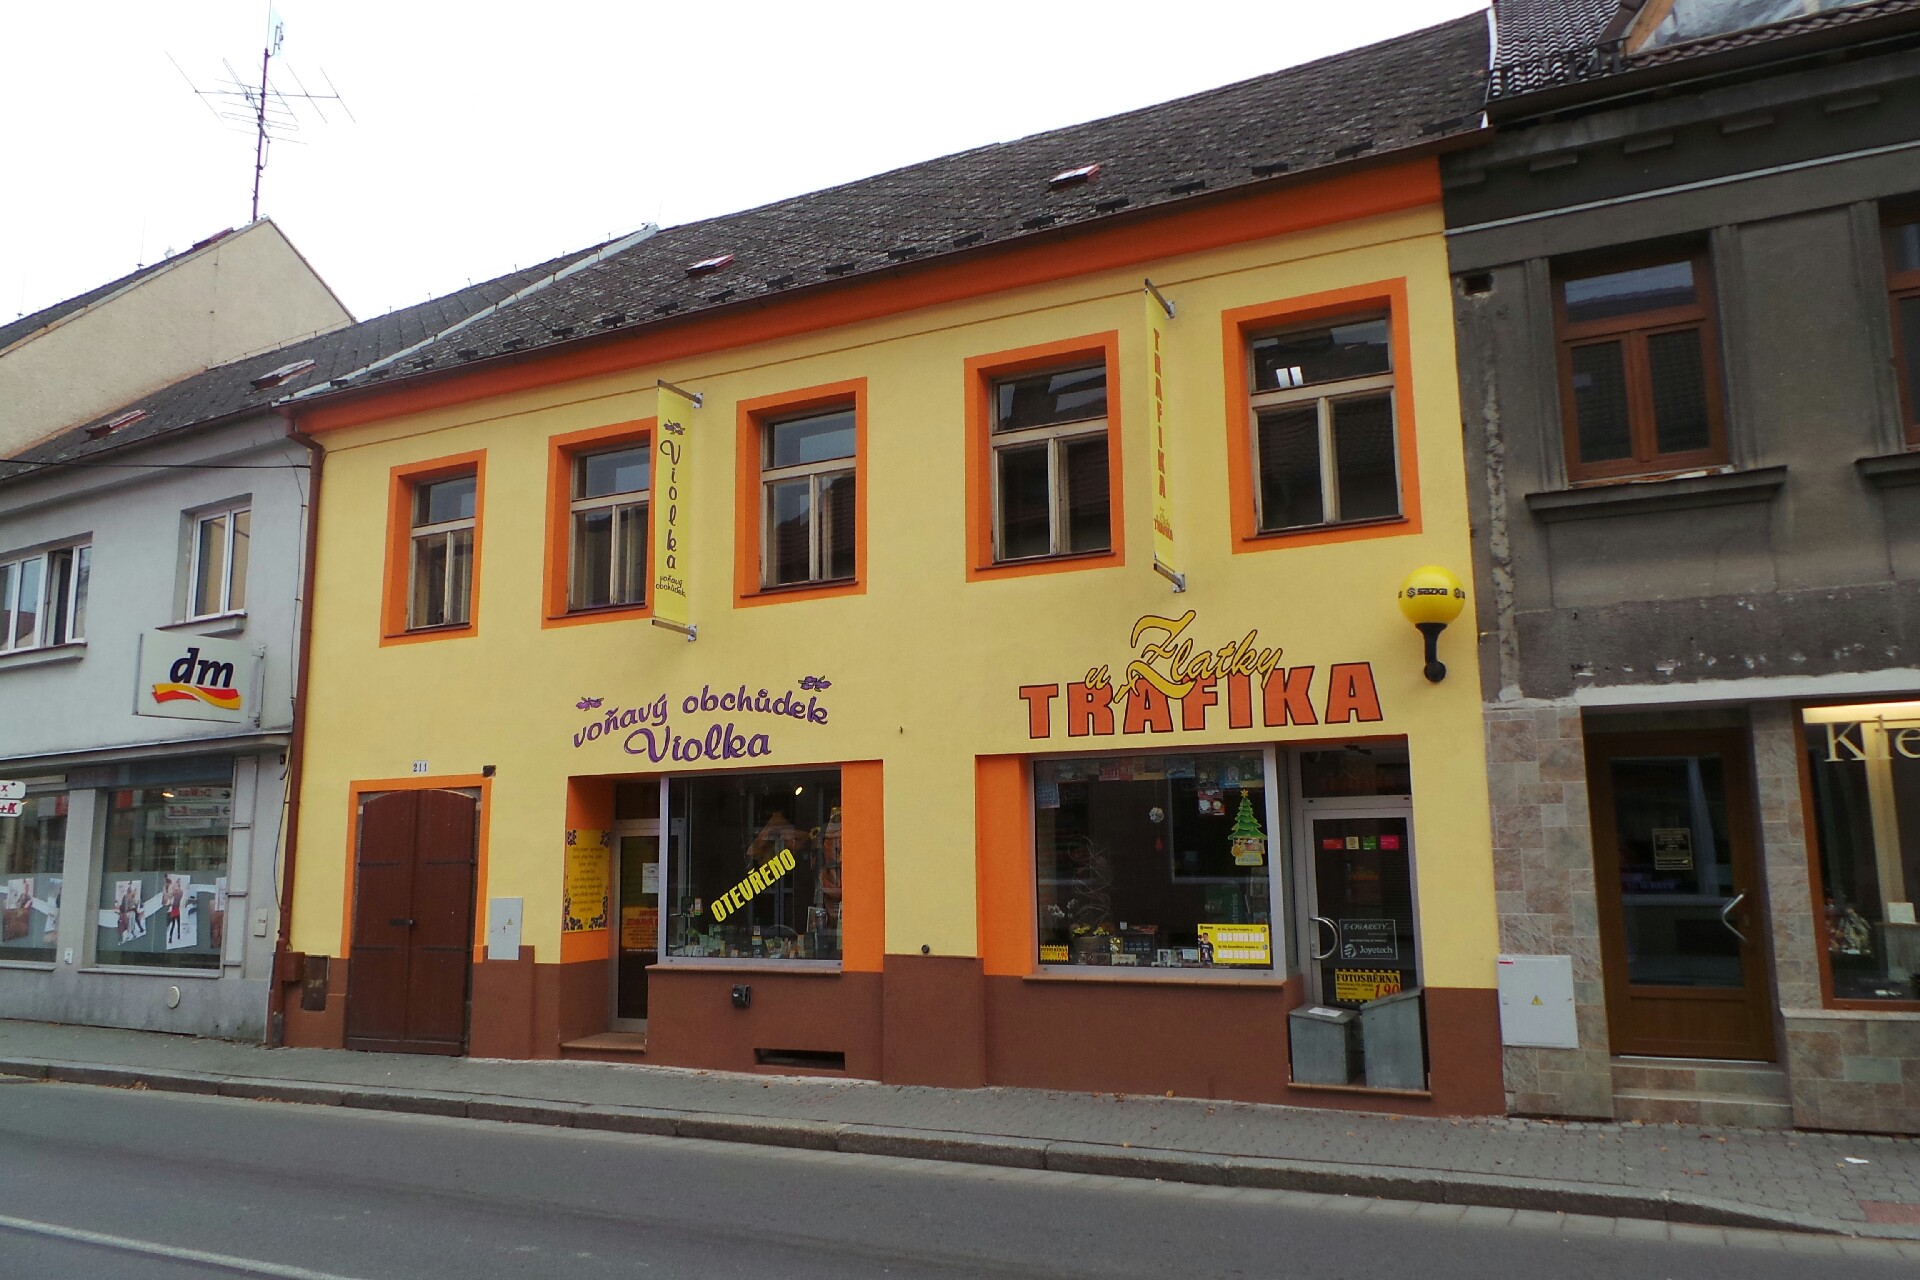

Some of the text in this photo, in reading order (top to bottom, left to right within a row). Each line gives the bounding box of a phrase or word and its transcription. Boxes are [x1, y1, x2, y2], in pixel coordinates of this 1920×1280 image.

[1153, 328, 1167, 499] TRAFIKA
[660, 440, 681, 569] Violka
[169, 648, 234, 688] dm
[1084, 609, 1283, 703] u Zlatky
[573, 685, 828, 748] voňavý obchůdek
[1019, 661, 1383, 739] TRAFIKA
[413, 762, 427, 773] 211
[623, 723, 772, 763] Violka
[710, 848, 796, 922] OTEVŘENO
[1360, 945, 1393, 955] Joyetech
